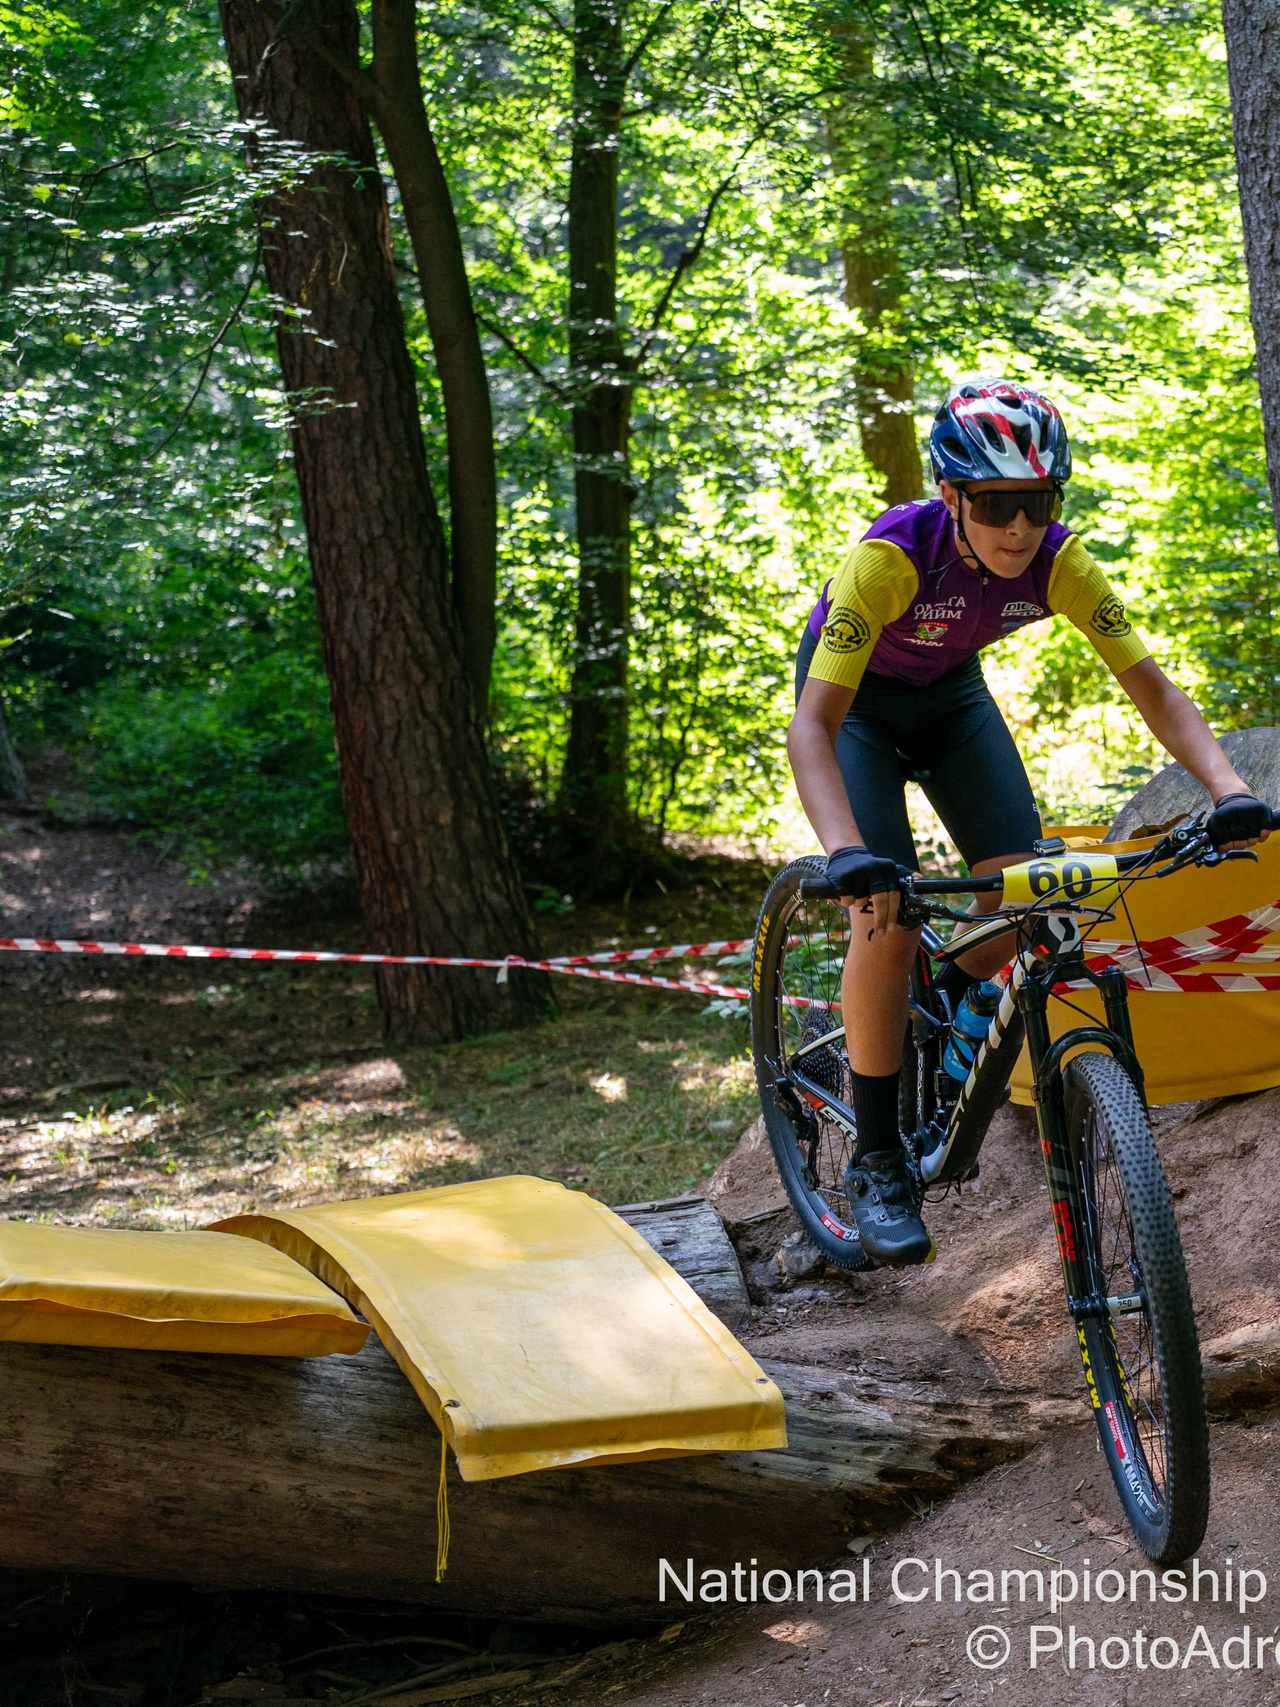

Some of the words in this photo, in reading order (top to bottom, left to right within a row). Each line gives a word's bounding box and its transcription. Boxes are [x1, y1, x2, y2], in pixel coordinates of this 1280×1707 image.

[914, 607, 963, 620] ИЙМ
[1028, 862, 1092, 900] 60
[752, 914, 770, 993] MAXXIS
[820, 1105, 858, 1141] SCO
[1076, 1321, 1101, 1408] MAXXI
